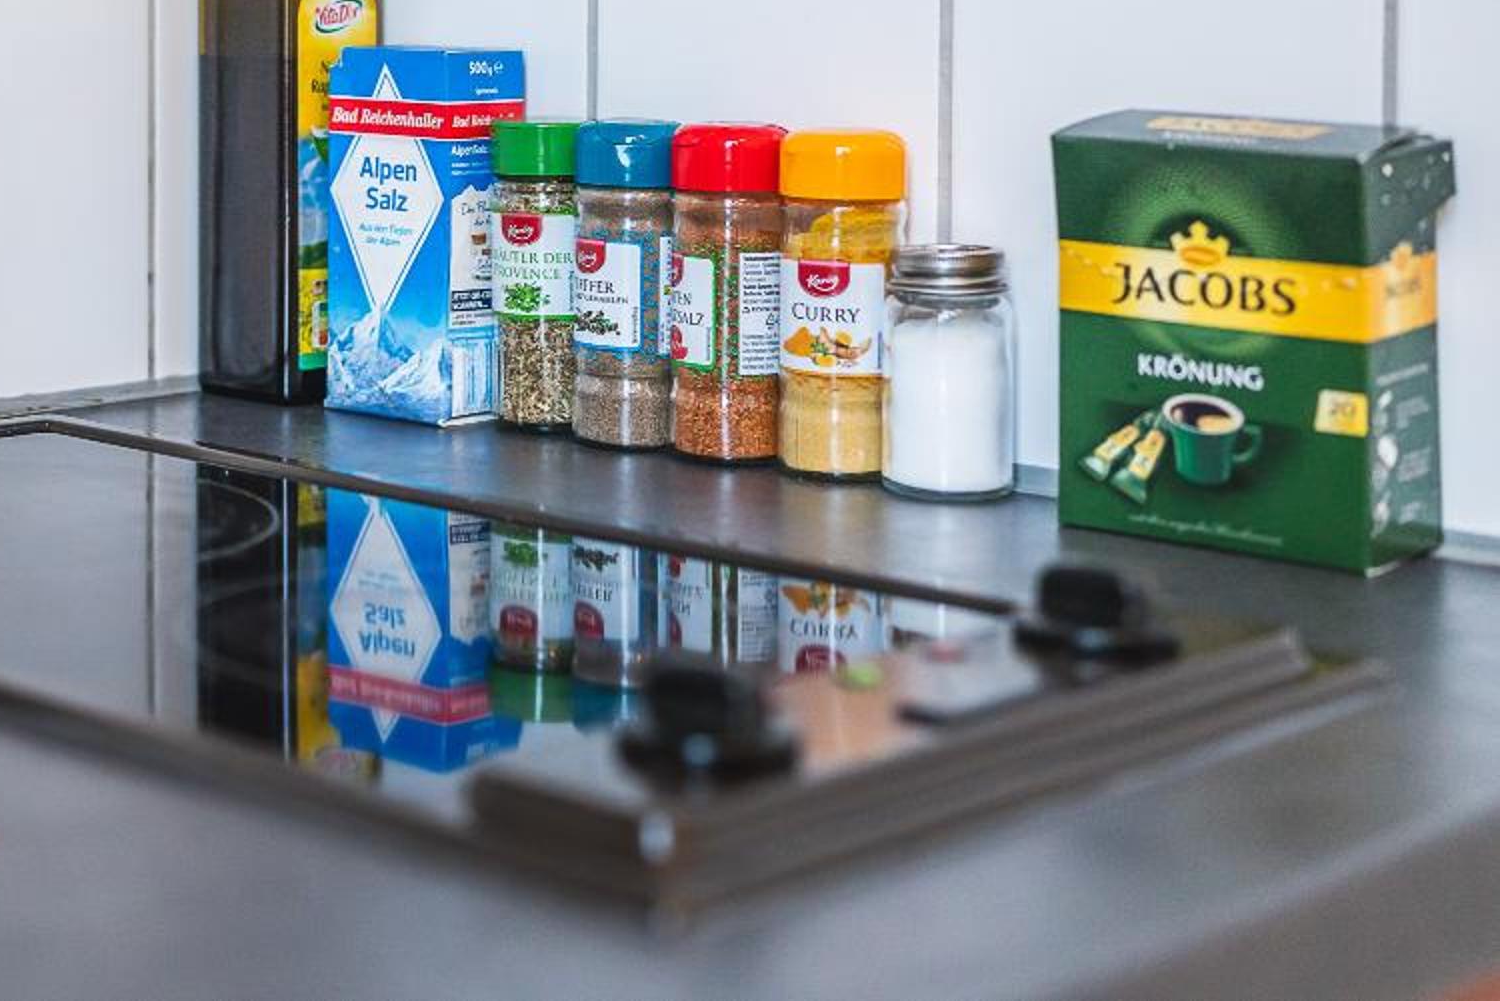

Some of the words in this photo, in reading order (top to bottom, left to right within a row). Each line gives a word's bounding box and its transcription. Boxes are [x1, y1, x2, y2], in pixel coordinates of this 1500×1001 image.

[331, 105, 359, 125] Bad
[360, 108, 444, 130] Reichenhaller
[359, 156, 417, 185] Alpen
[365, 186, 409, 212] Salz
[1112, 262, 1297, 318] JACOBS
[791, 302, 861, 323] CURRY
[1136, 351, 1265, 392] KRÖNUNG
